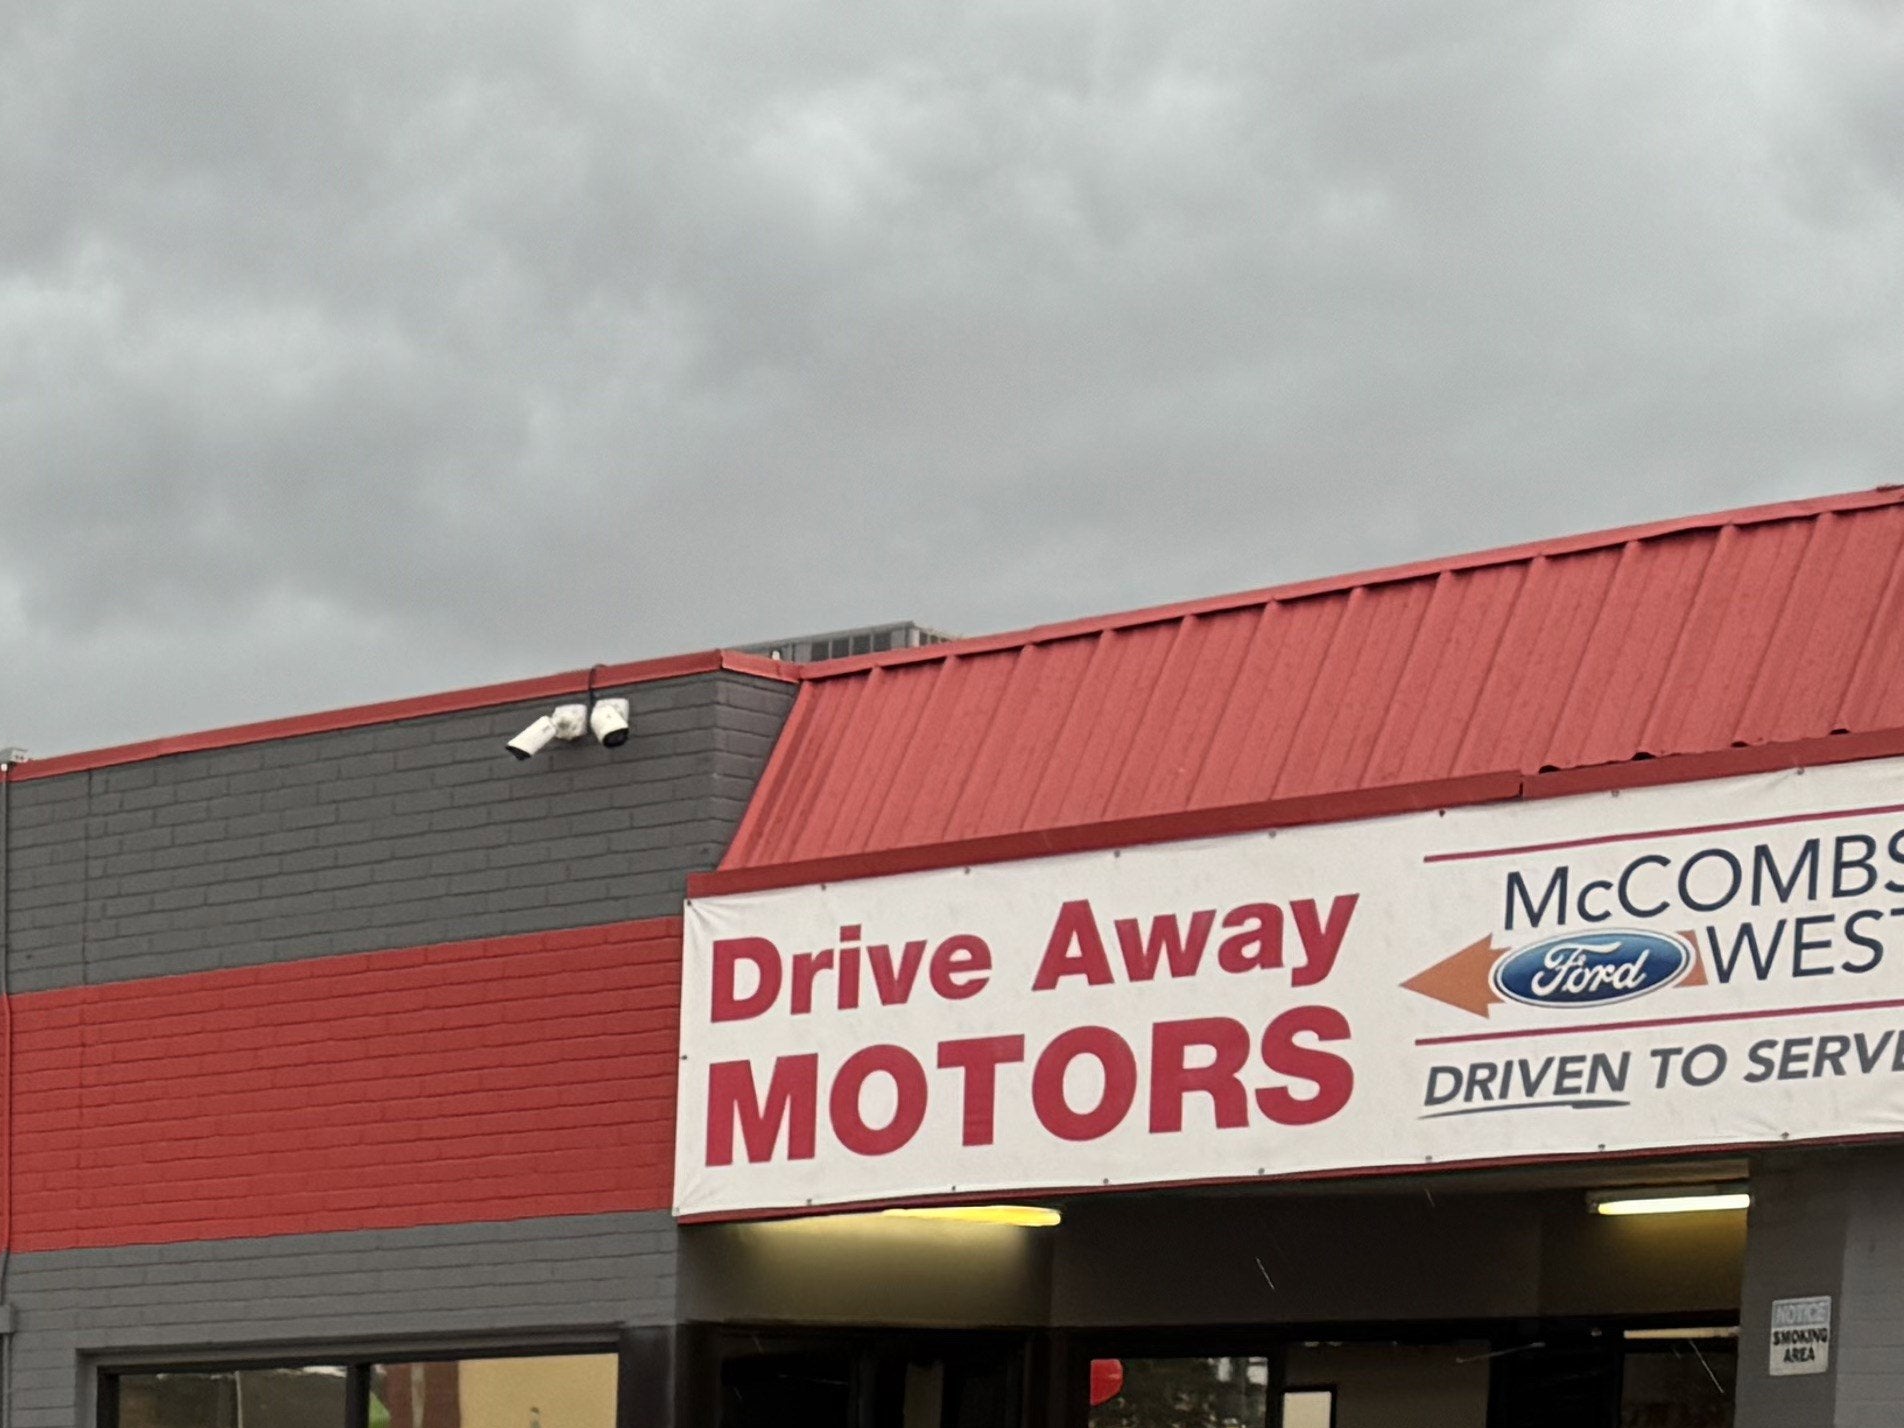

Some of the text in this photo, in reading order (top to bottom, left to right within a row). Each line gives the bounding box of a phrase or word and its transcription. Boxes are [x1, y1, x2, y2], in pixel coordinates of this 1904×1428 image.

[711, 895, 1359, 1023] Drive Away
[1531, 940, 1649, 998] Ford
[705, 1005, 1355, 1168] MOTORS
[1424, 1051, 1631, 1107] DRIVEN
[1650, 1044, 1727, 1089] TO
[1773, 1328, 1828, 1347] SMOKING
[1783, 1347, 1816, 1363] AREA
